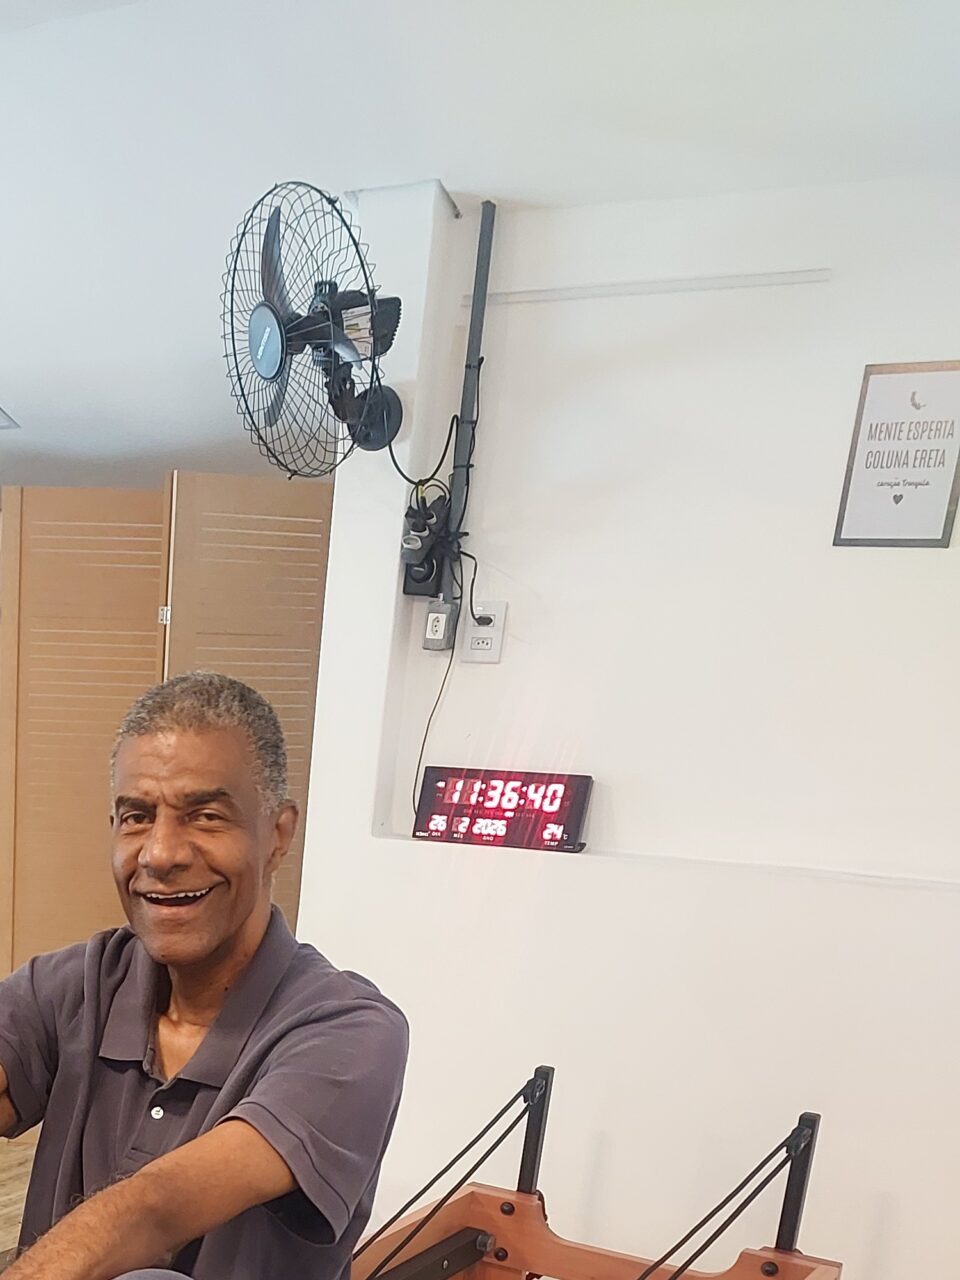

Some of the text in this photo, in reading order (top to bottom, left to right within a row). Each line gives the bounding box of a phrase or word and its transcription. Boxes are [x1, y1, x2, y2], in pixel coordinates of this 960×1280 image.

[867, 420, 955, 441] MENTE ESPERTA
[865, 448, 946, 469] COLUNA ERETA
[451, 779, 565, 813] 11:36:40
[428, 815, 448, 831] 26
[472, 818, 508, 836] 2026
[542, 823, 564, 841] 24
